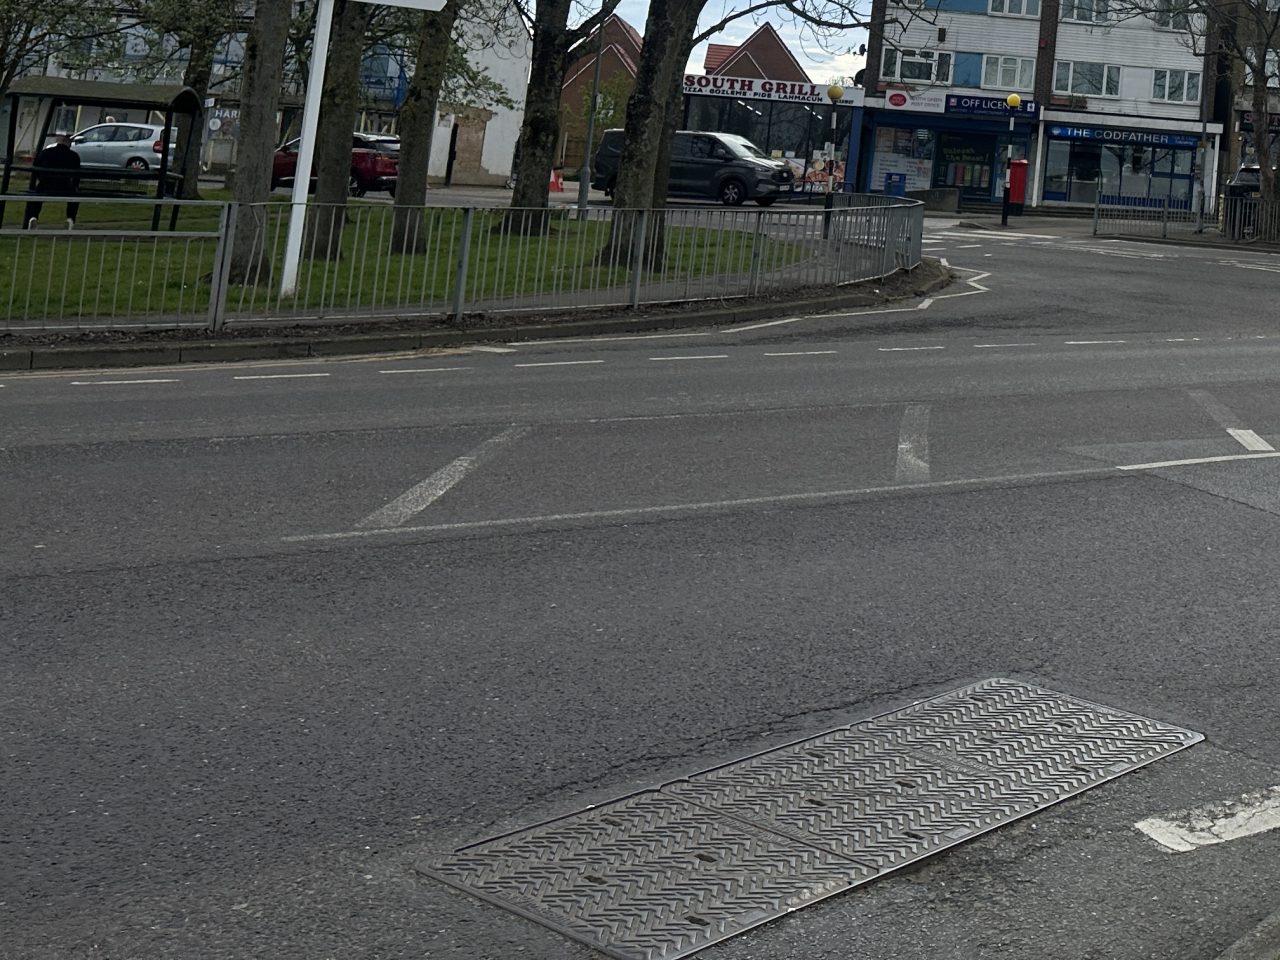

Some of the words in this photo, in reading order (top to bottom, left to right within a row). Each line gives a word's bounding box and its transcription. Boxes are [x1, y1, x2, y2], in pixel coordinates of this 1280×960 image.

[684, 74, 754, 92] SOUTH
[761, 81, 821, 97] GRILL
[753, 91, 772, 99] PIDE
[778, 94, 823, 102] LAHMACUN
[961, 98, 980, 108] OFF
[982, 101, 1023, 111] LICENE
[1066, 127, 1091, 138] THE
[1094, 129, 1169, 144] CODFATHER
